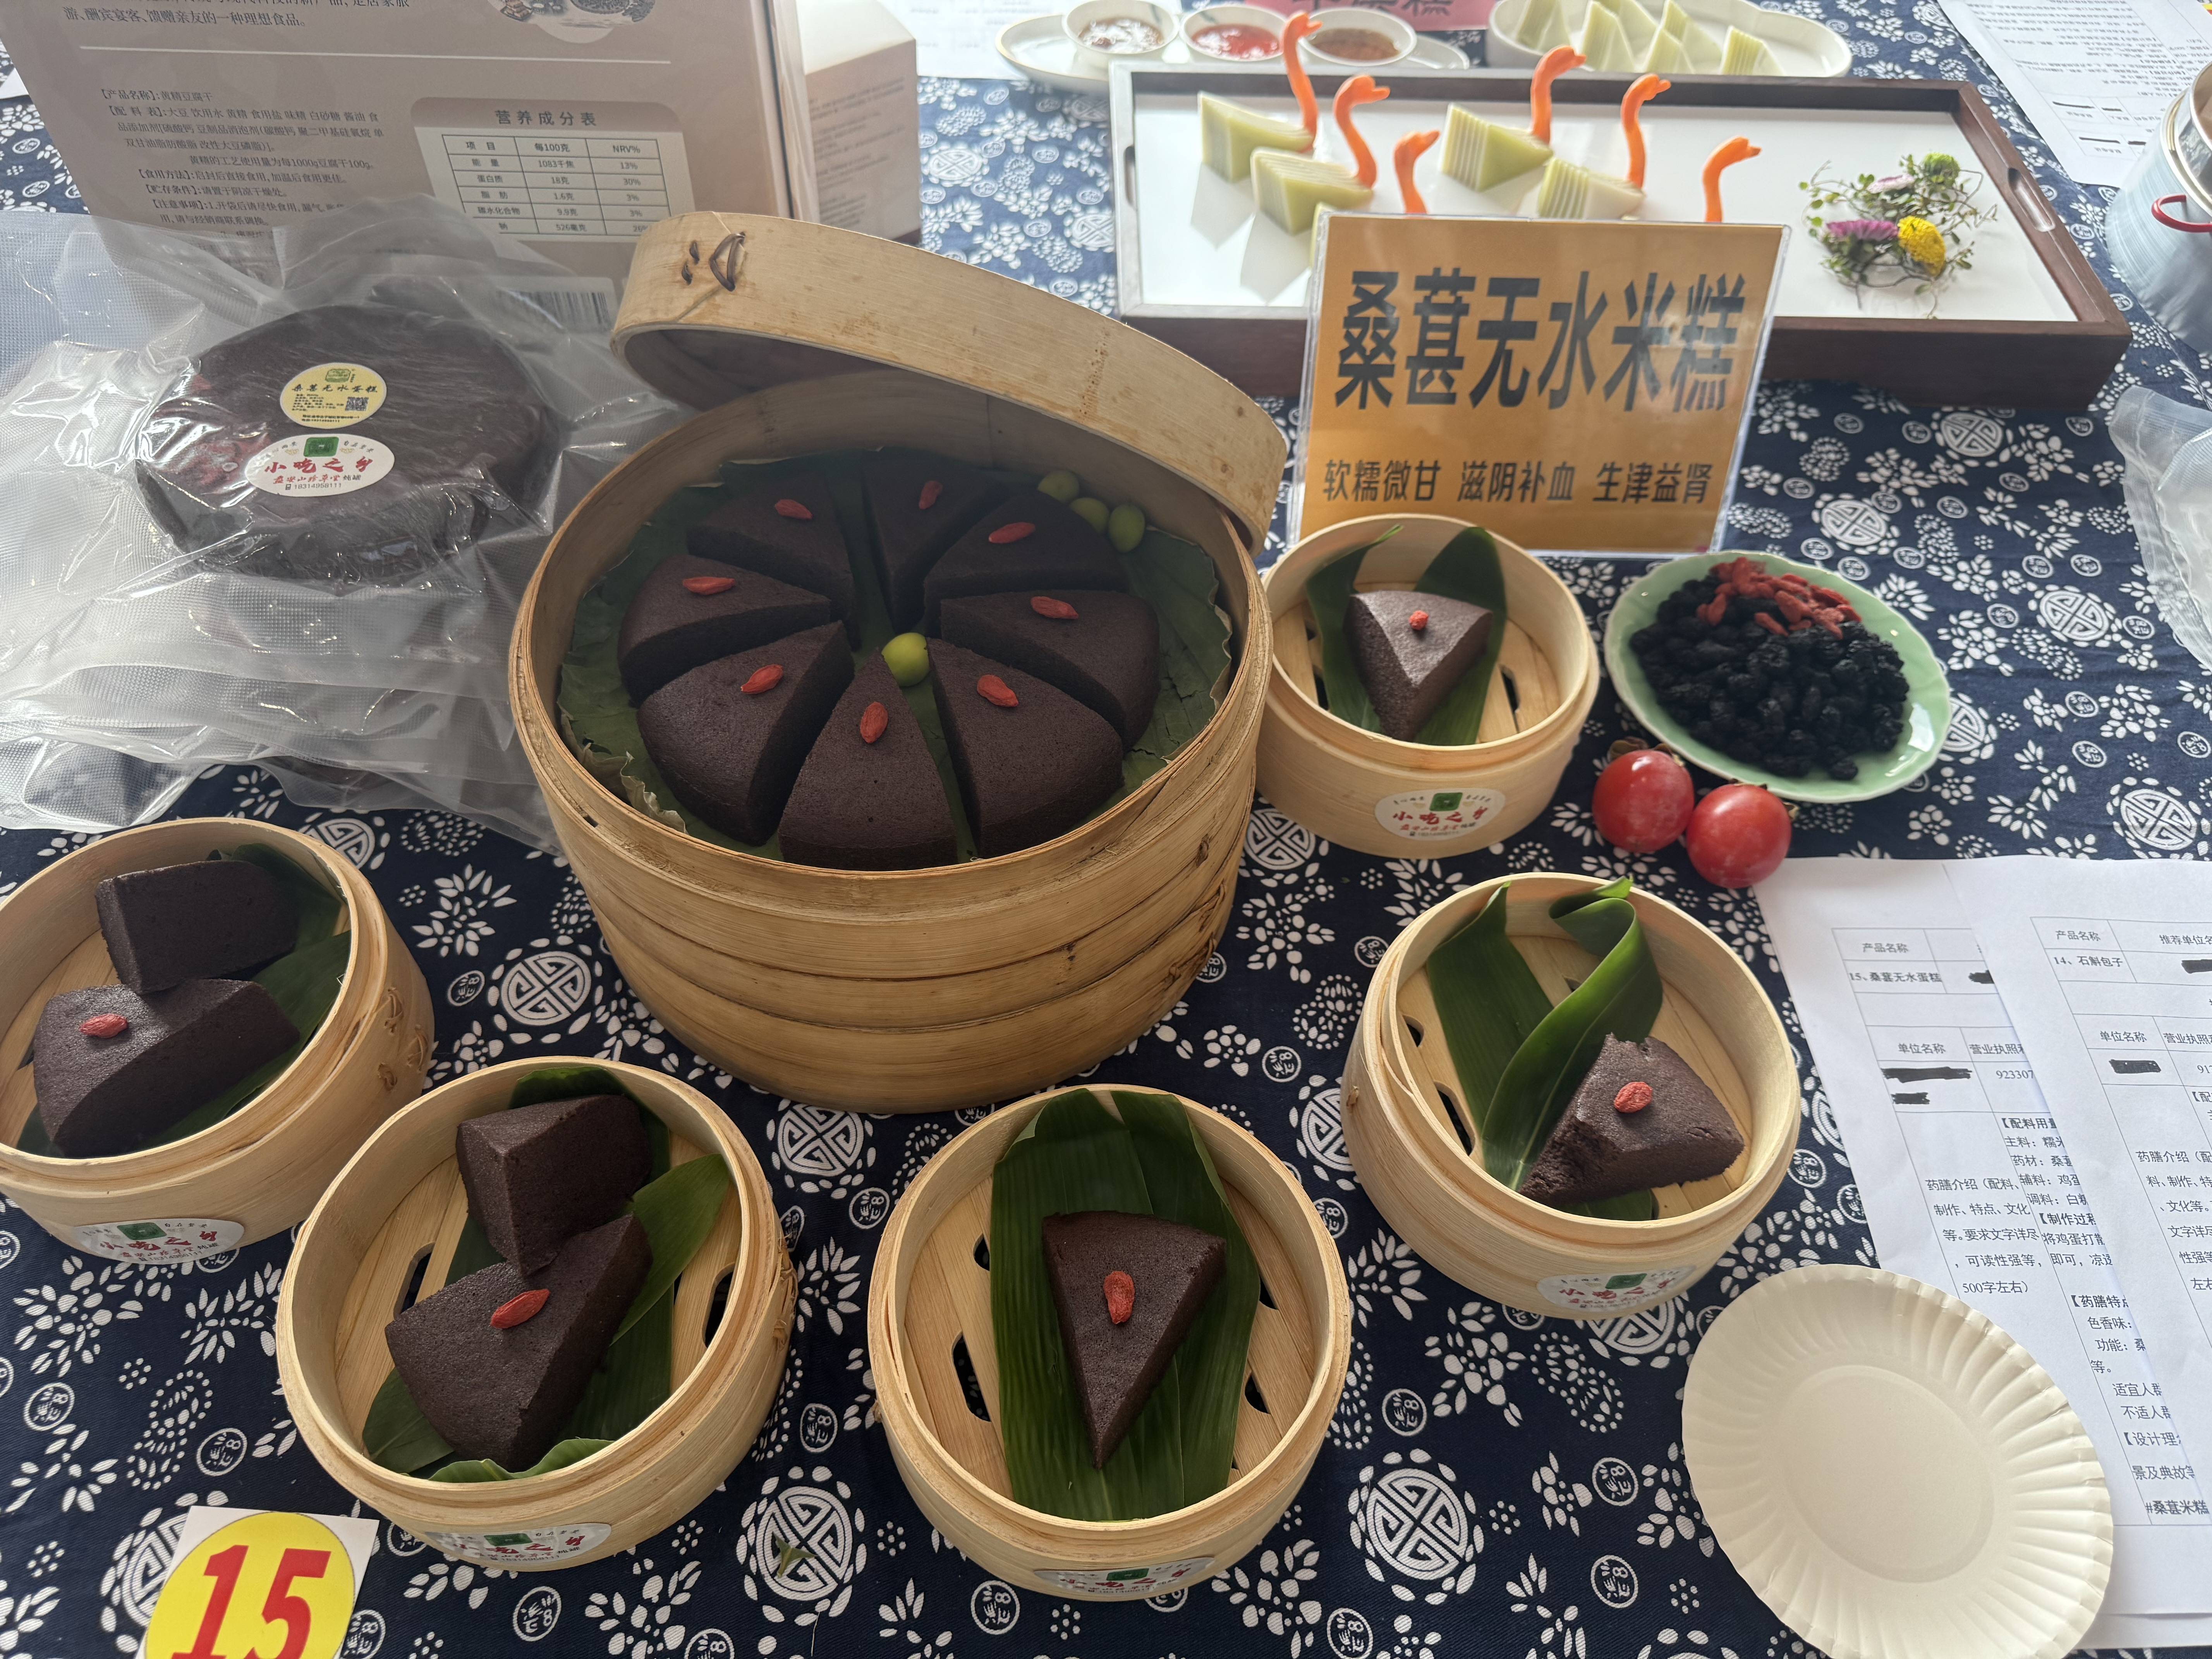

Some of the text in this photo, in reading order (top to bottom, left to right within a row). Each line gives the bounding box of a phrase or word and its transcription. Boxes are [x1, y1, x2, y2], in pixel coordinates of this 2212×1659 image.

[495, 110, 597, 127] 营养成分表
[534, 143, 570, 153] 每100克
[612, 144, 641, 154] NRV%
[477, 174, 503, 184] 蛋白质
[623, 178, 641, 186] 30%
[1334, 266, 1746, 412] 桑葚无水米糕
[264, 456, 373, 474] 小吃之乡
[1322, 459, 1714, 505] 软糯微甘 滋阴补血 生津益肾
[2055, 930, 2101, 942] 产品名称
[1862, 943, 1909, 953] 产品名称
[2054, 956, 2123, 967] 14、石斛包子
[1849, 972, 1942, 983] 15、桑葚无水蛋糕
[2100, 1030, 2147, 1043] 单位名称
[1898, 1043, 1946, 1054] 单位名称
[1933, 1203, 2030, 1216] 制作、特点、文化
[2160, 1200, 2212, 1212] 、文化等。
[1942, 1228, 2040, 1242] 等。要求文字详尽
[1962, 1280, 2029, 1295] 500字左右）
[2087, 1316, 2132, 1329] 色香味：
[2090, 1360, 2111, 1374] 等。
[171, 1544, 332, 1659] 15
